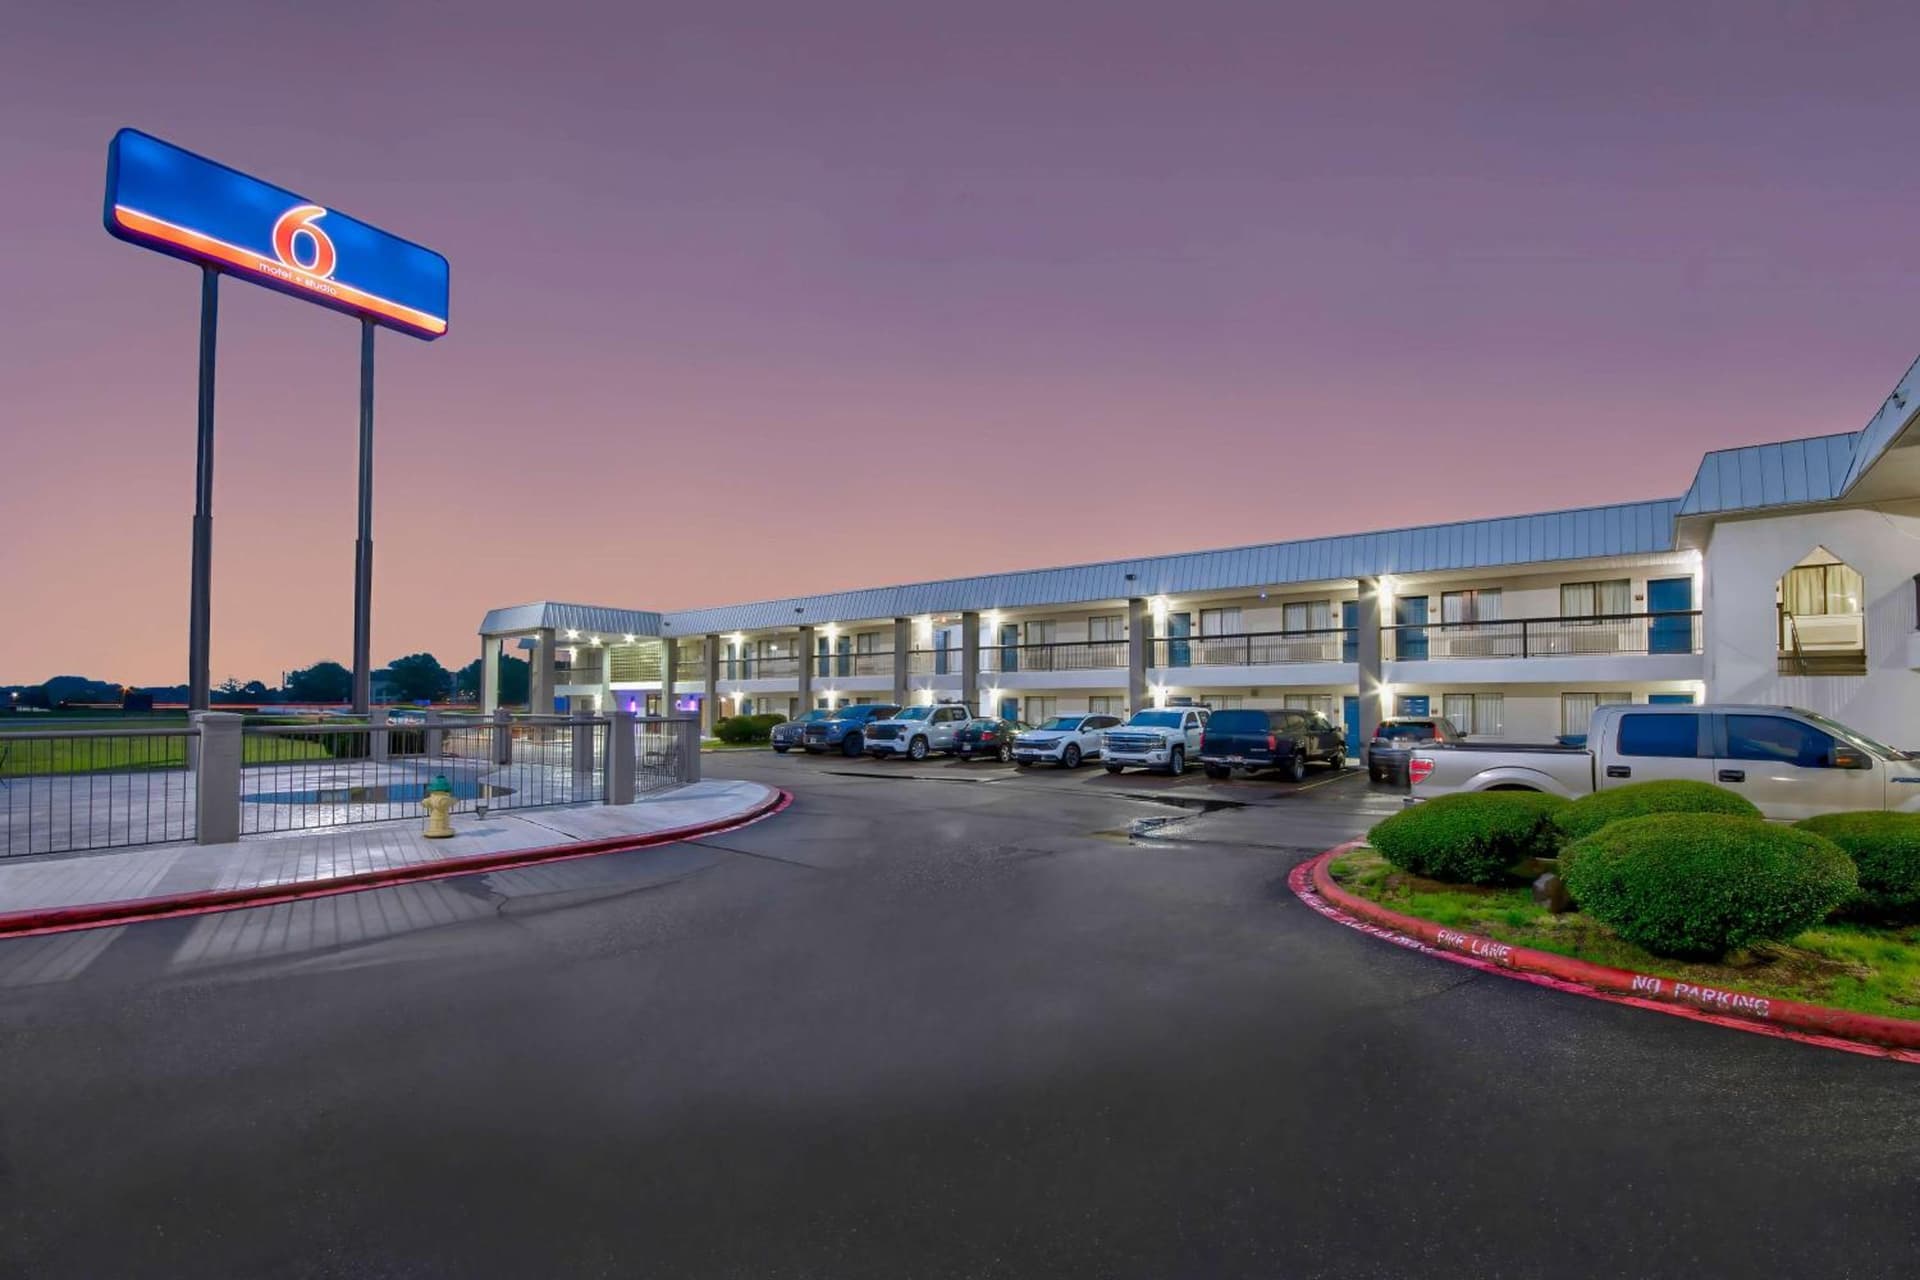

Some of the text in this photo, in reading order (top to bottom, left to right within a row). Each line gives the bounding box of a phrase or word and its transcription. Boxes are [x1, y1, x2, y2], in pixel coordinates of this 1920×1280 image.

[273, 205, 336, 279] 6
[1632, 975, 1770, 1016] NO PARKING
